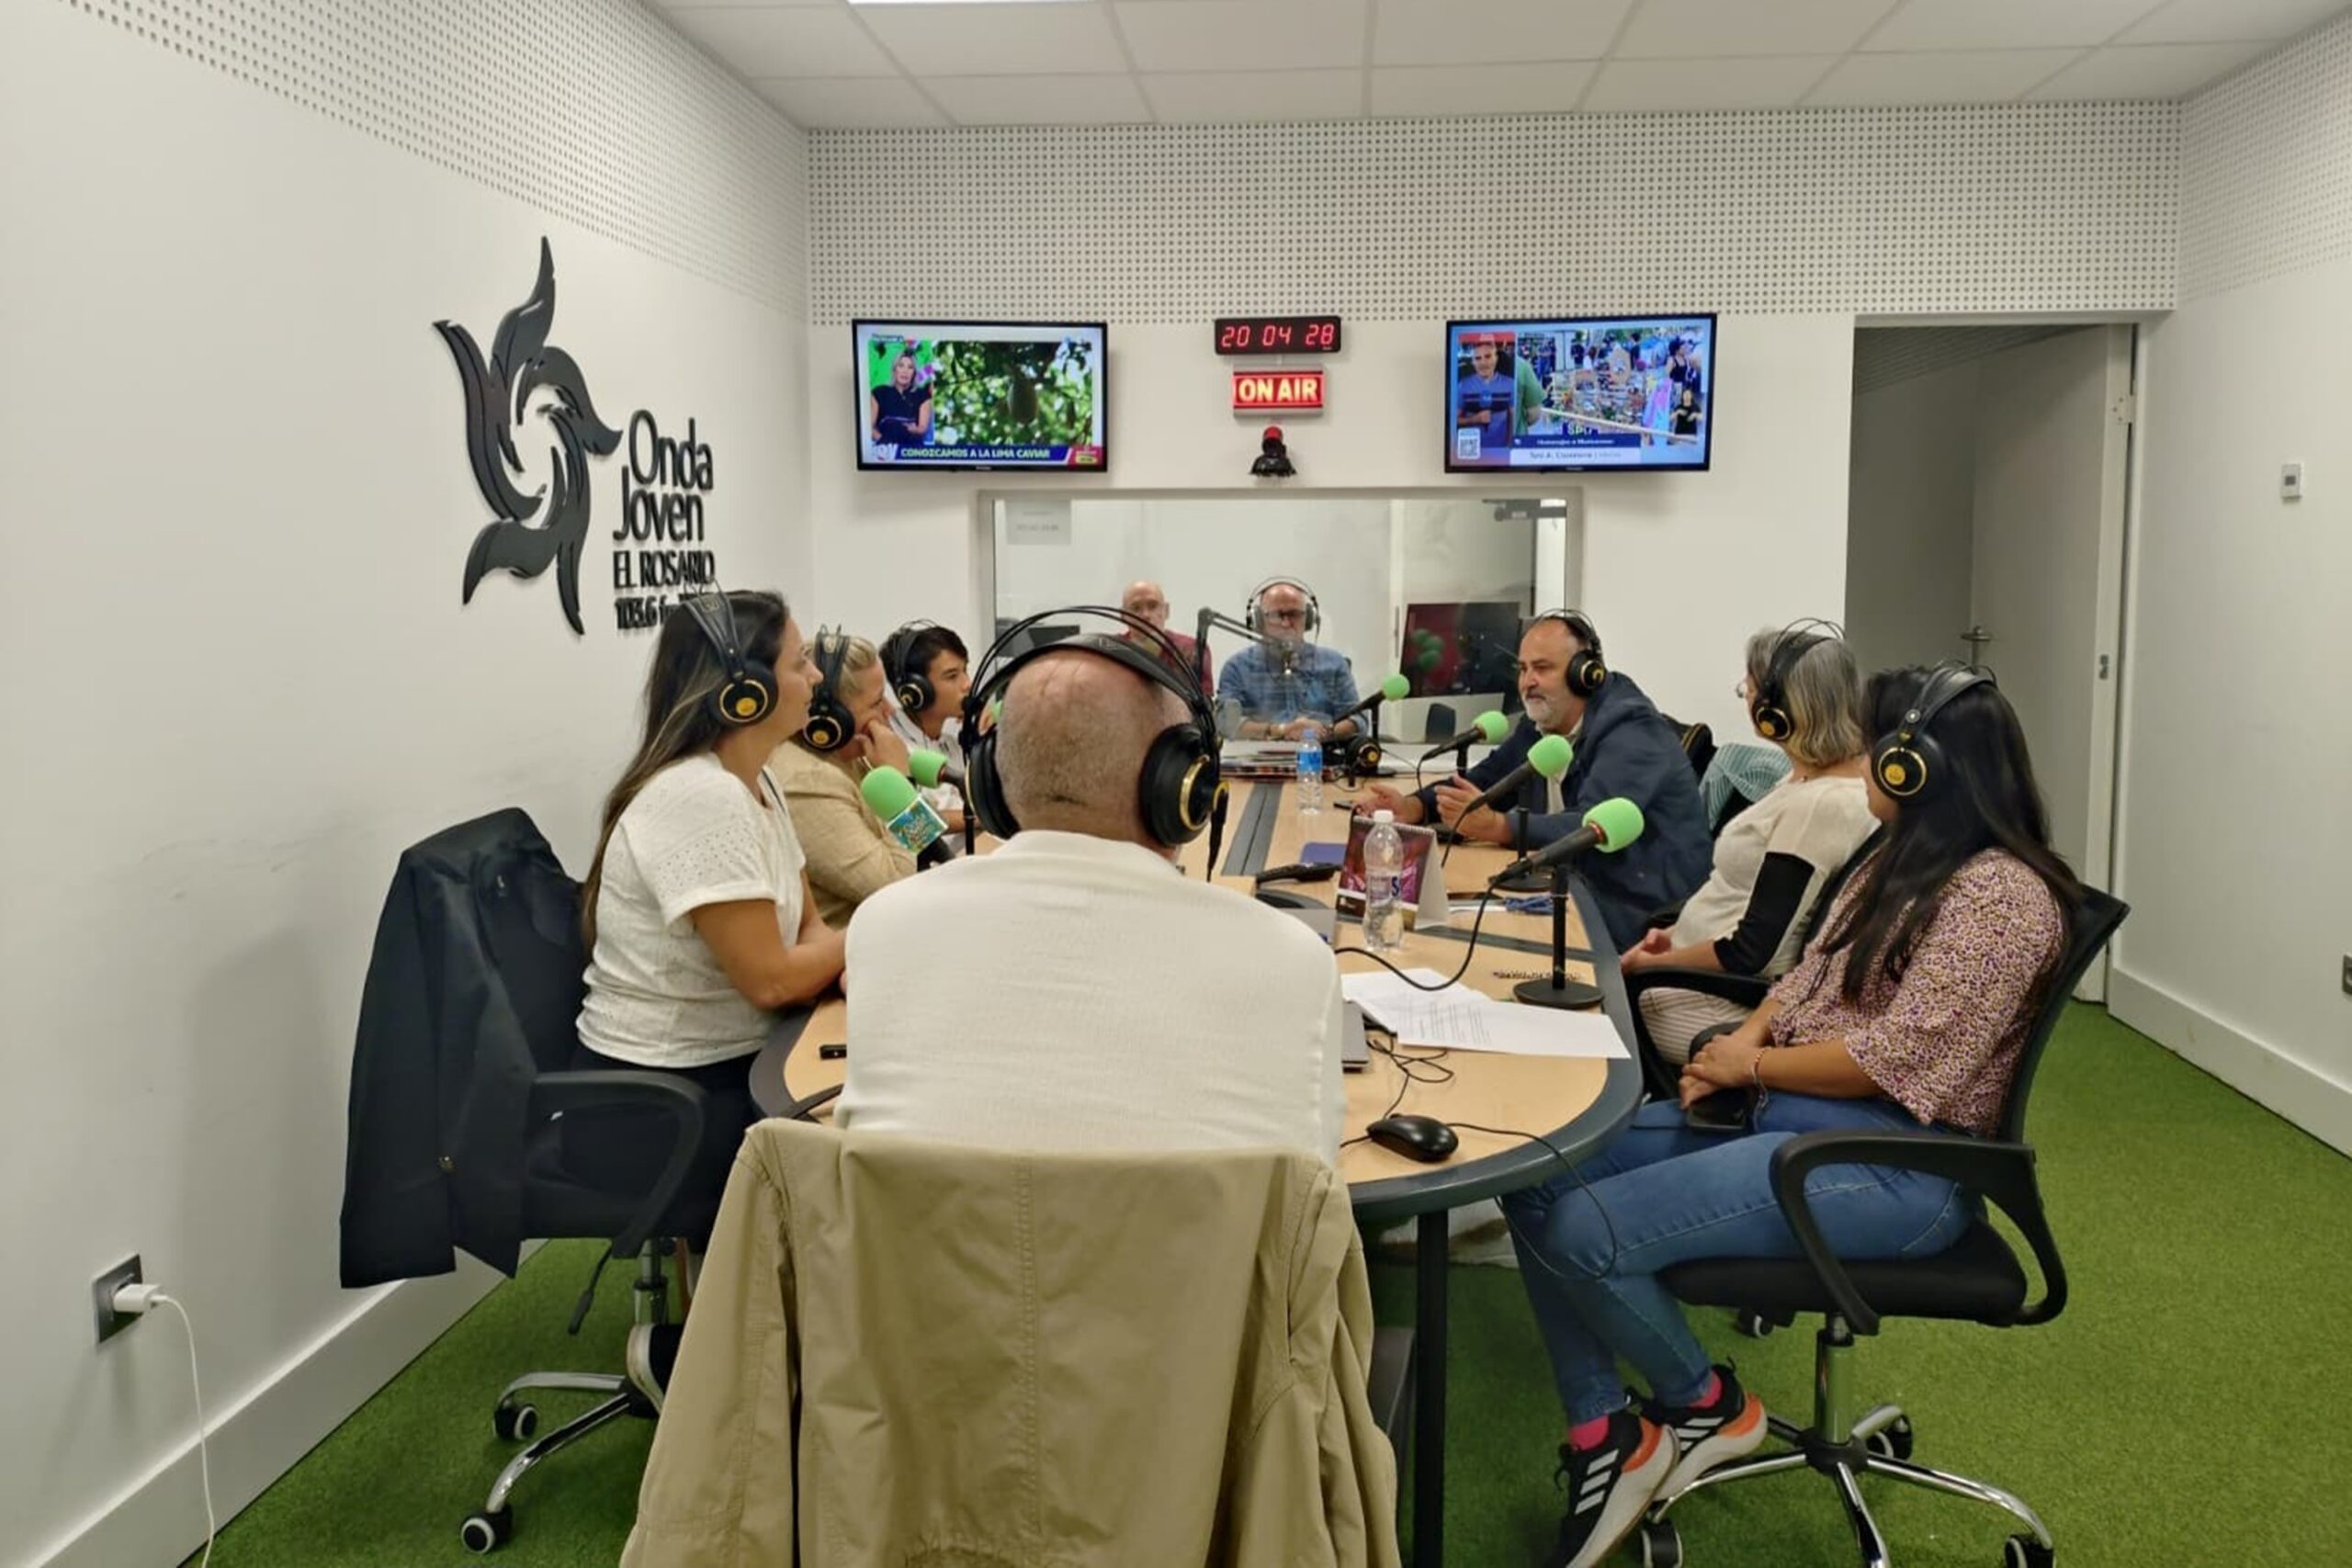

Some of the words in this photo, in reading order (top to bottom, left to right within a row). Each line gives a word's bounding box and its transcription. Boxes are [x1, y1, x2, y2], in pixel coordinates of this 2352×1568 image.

[1222, 326, 1250, 347] 20
[1262, 325, 1292, 346] 04
[1306, 323, 1335, 344] 28
[1238, 378, 1273, 401] ON
[1276, 378, 1317, 401] AIR
[628, 409, 714, 491] Onda
[900, 447, 968, 458] CONOZCAMOS
[969, 448, 978, 457] A
[978, 448, 990, 457] LA
[612, 465, 705, 543] Joven
[613, 549, 638, 589] EL
[639, 549, 716, 587] ROSARIO
